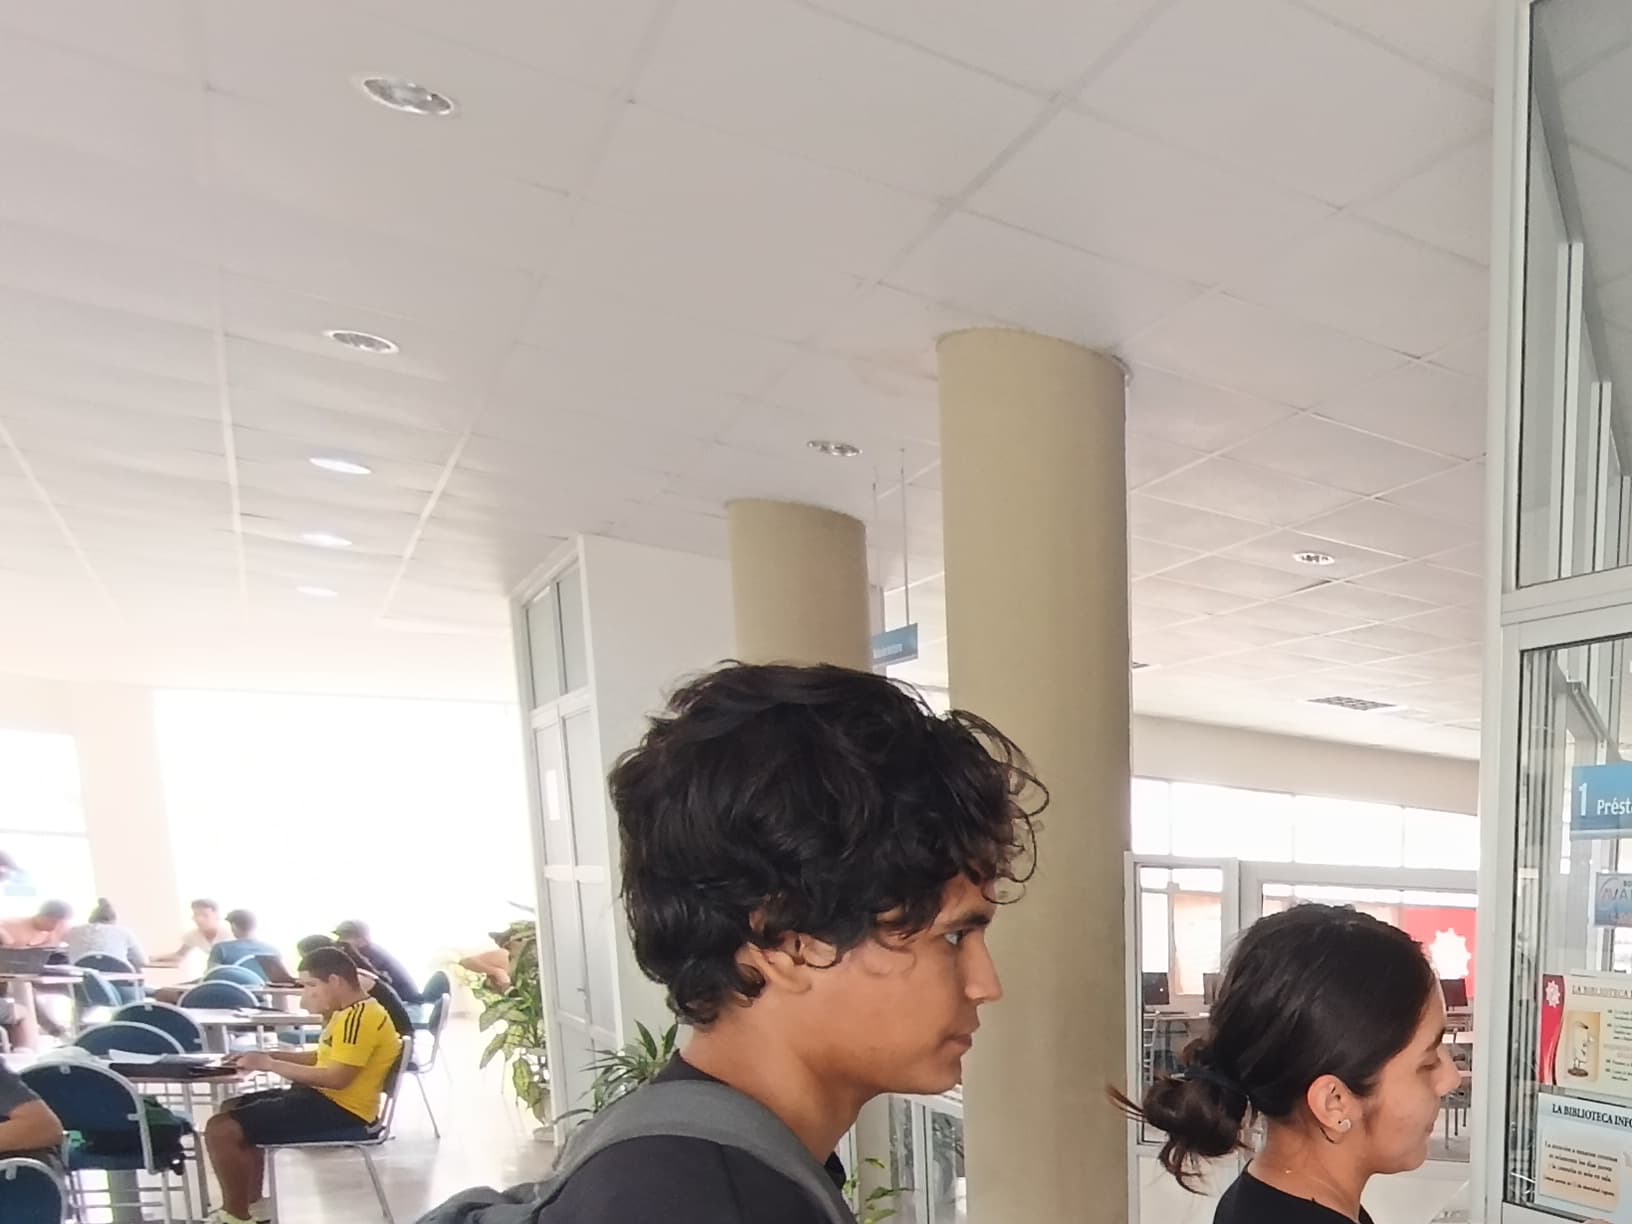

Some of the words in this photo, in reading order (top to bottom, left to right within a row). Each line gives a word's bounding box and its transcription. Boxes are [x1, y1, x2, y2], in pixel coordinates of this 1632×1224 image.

[1578, 782, 1588, 817] 1
[1552, 1103, 1562, 1114] LA
[1564, 1105, 1613, 1124] BIBLIOTECA
